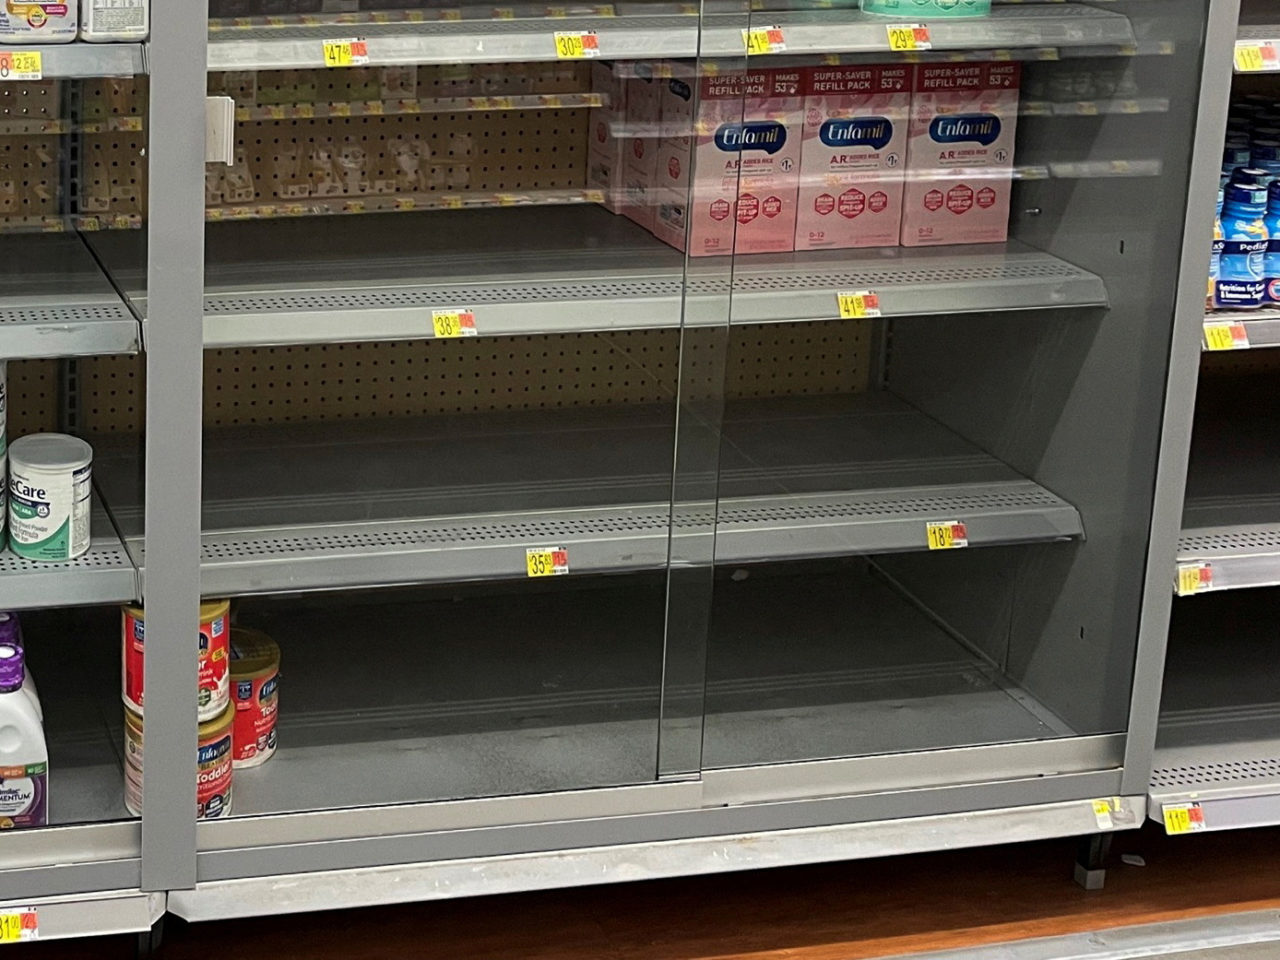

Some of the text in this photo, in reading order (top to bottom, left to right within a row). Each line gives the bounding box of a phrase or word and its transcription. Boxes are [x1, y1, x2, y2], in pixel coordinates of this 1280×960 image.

[814, 70, 871, 81] SUPER-SAVER
[882, 68, 906, 78] MAKES
[814, 80, 871, 92] REFILL PACK
[880, 78, 893, 89] 53
[828, 120, 885, 141] Enfamil
